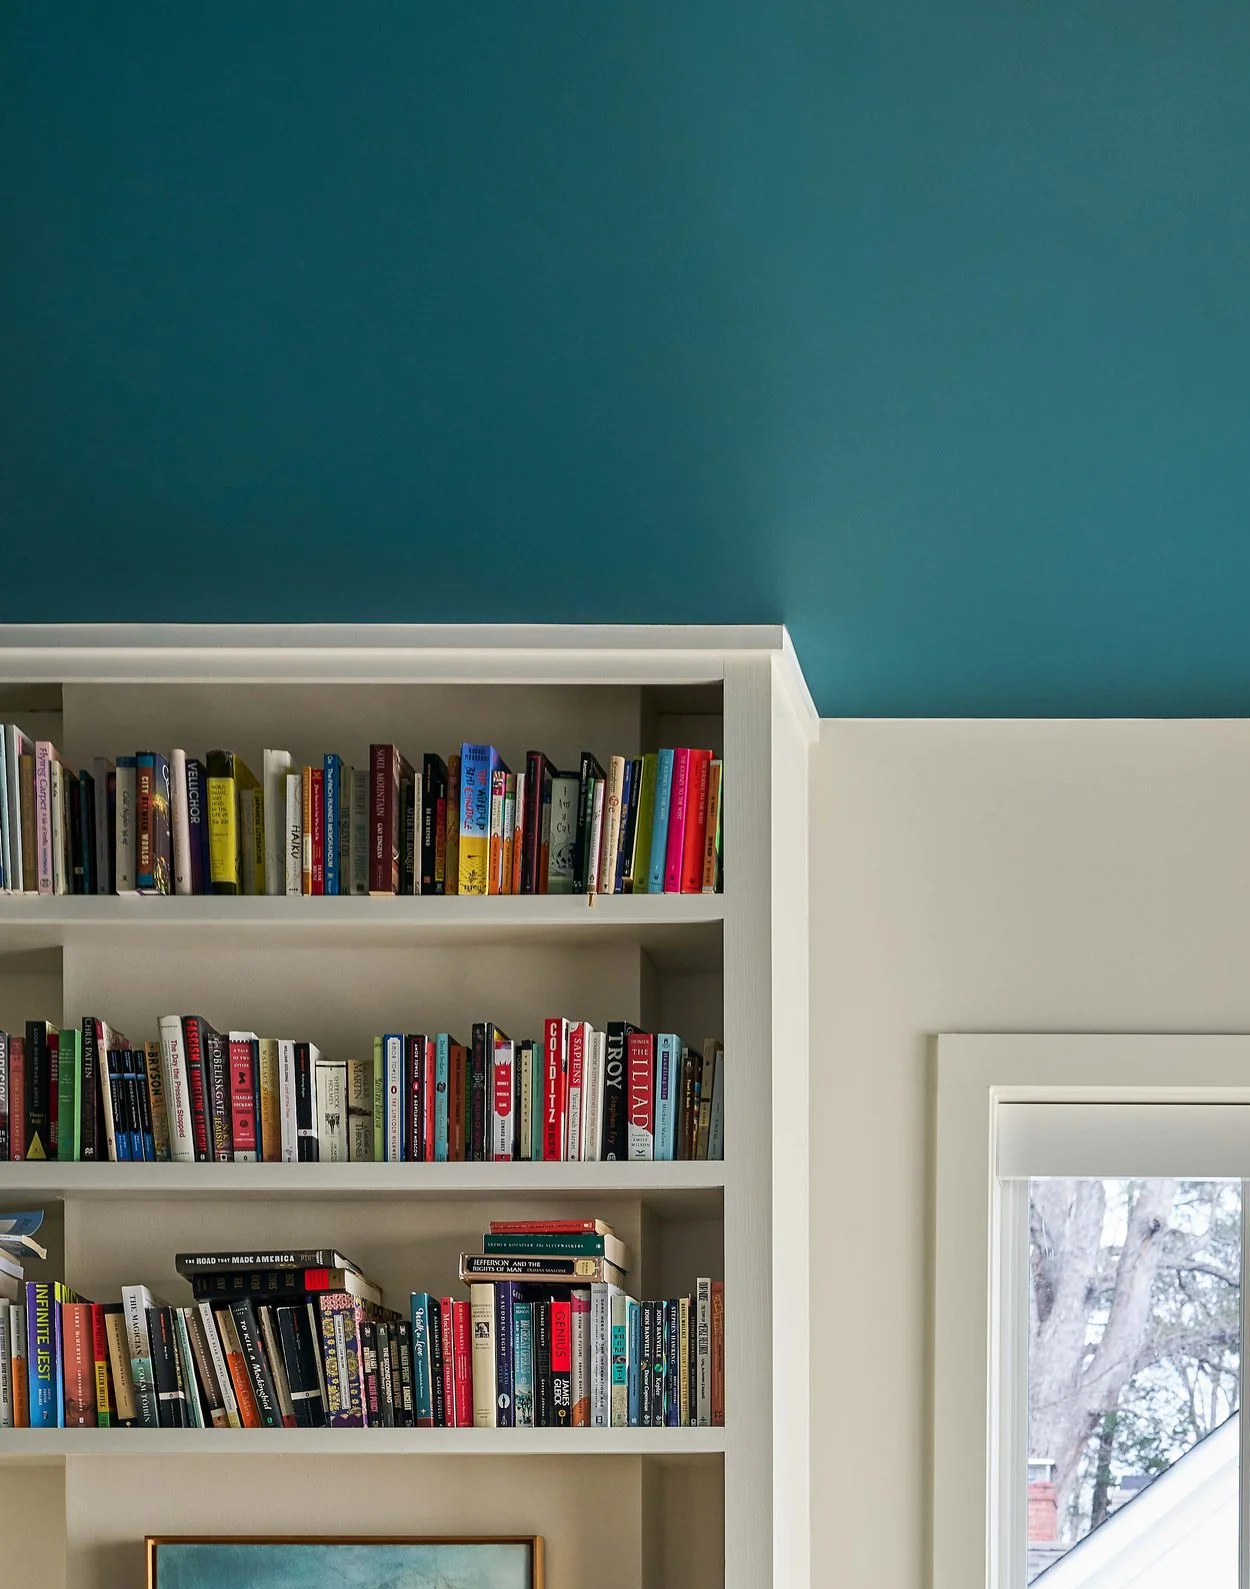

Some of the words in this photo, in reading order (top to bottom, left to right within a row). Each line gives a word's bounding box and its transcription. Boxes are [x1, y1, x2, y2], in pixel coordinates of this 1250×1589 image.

[38, 747, 49, 776] Flying
[376, 748, 385, 770] SOUL
[141, 776, 149, 794] CITY
[187, 762, 201, 824] VELLICHOR
[376, 772, 385, 817] MOUNTAIN
[141, 834, 149, 865] WORLDS
[290, 824, 301, 859] HAIKU
[84, 1017, 93, 1044] CHRIS
[170, 1040, 178, 1052] The
[185, 1019, 200, 1061] FASCISM
[84, 1047, 93, 1078] PATTEN
[147, 1051, 162, 1096] BRYSON
[170, 1054, 180, 1067] Day
[172, 1068, 180, 1079] the
[572, 1037, 582, 1084] SAPIENS
[606, 1032, 624, 1090] TROY
[173, 1081, 183, 1108] Presses
[190, 1069, 205, 1113] MADELEINE
[631, 1059, 649, 1129] ILIAD
[174, 1109, 186, 1138] Stopped
[194, 1115, 207, 1152] ALBRIGHT
[196, 1257, 216, 1265] ROAD
[231, 1256, 254, 1264] MADE
[255, 1255, 295, 1264] AMERICA
[35, 1283, 51, 1345] INFINITE
[129, 1294, 139, 1312] THE
[131, 1314, 144, 1356] MAGICIAN
[240, 1320, 249, 1331] TO
[554, 1310, 569, 1358] GENIUS
[243, 1333, 253, 1353] KILL
[36, 1348, 52, 1381] JEST
[138, 1367, 149, 1393] COLM
[251, 1363, 273, 1411] Mockingbird
[553, 1378, 562, 1406] GLEICK
[561, 1378, 571, 1406] JAMES
